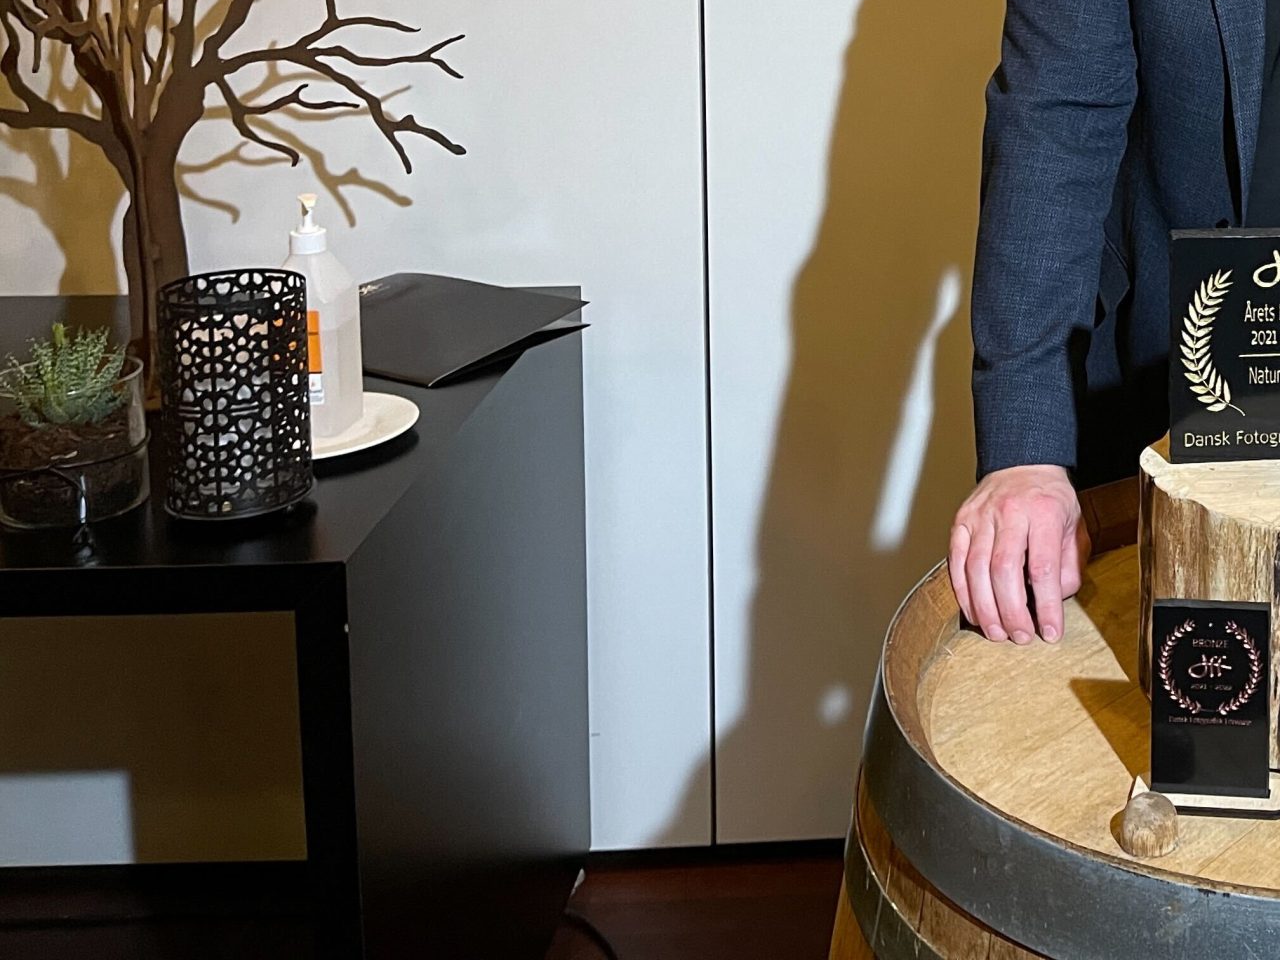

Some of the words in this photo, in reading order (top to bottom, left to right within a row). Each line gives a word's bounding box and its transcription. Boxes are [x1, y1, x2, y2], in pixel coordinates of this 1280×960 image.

[1244, 300, 1275, 323] Årets
[1251, 330, 1278, 346] 2021
[1249, 366, 1280, 385] Natur
[1184, 431, 1231, 448] Dansk
